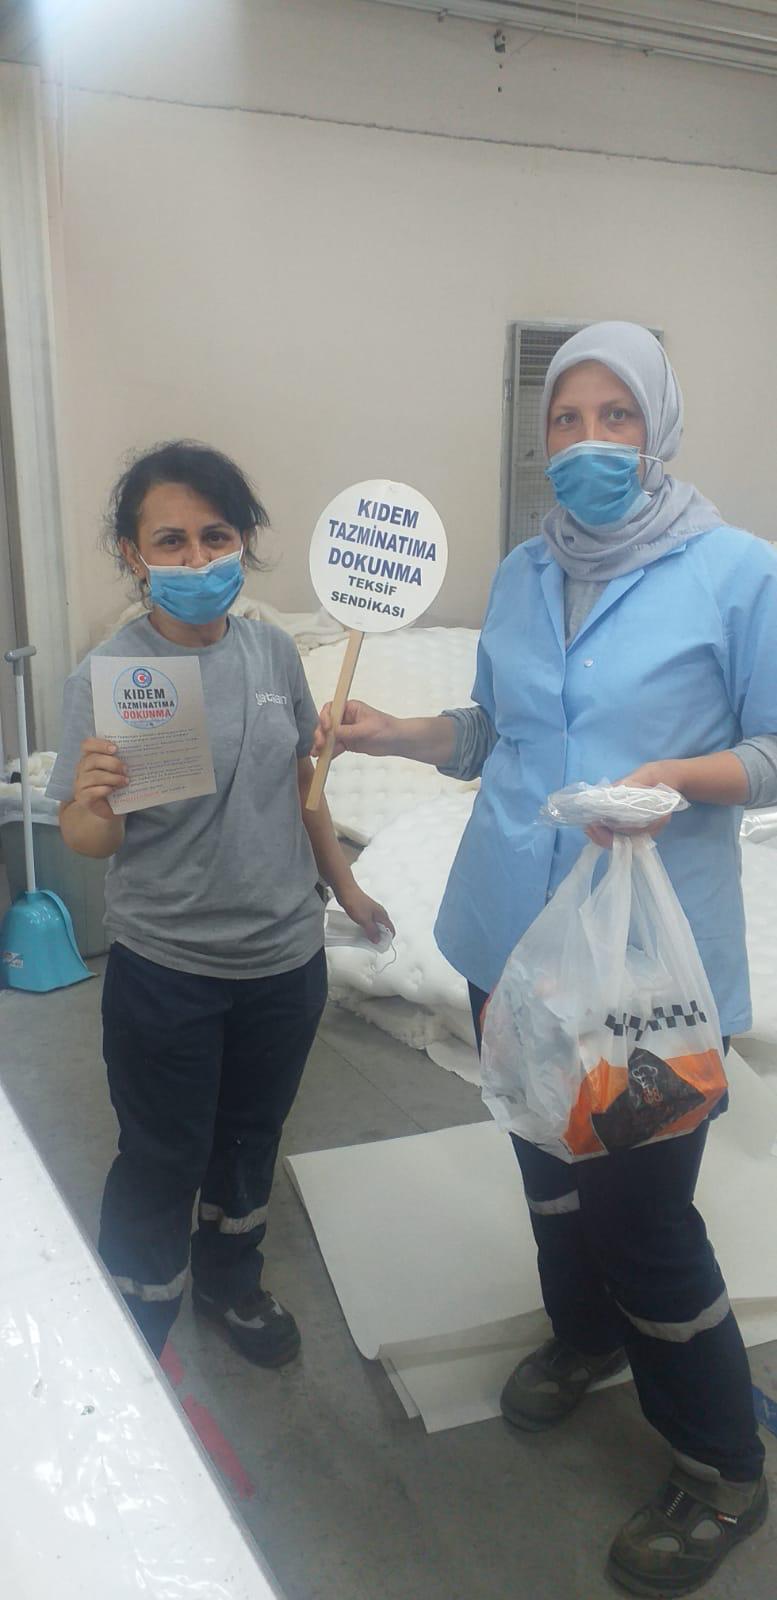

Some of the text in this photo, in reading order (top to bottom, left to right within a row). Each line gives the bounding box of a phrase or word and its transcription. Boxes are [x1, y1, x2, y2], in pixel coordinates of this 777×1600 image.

[357, 498, 419, 528] KIDEM
[329, 519, 437, 561] TAZMİNATIMA
[328, 547, 422, 586] DOKUNMA
[348, 575, 397, 596] TEKSİF
[330, 591, 405, 618] SENDİKASI
[118, 700, 175, 709] TAZMİNATIMA
[124, 688, 165, 700] KIDEM
[123, 709, 172, 719] DOKUNMA
